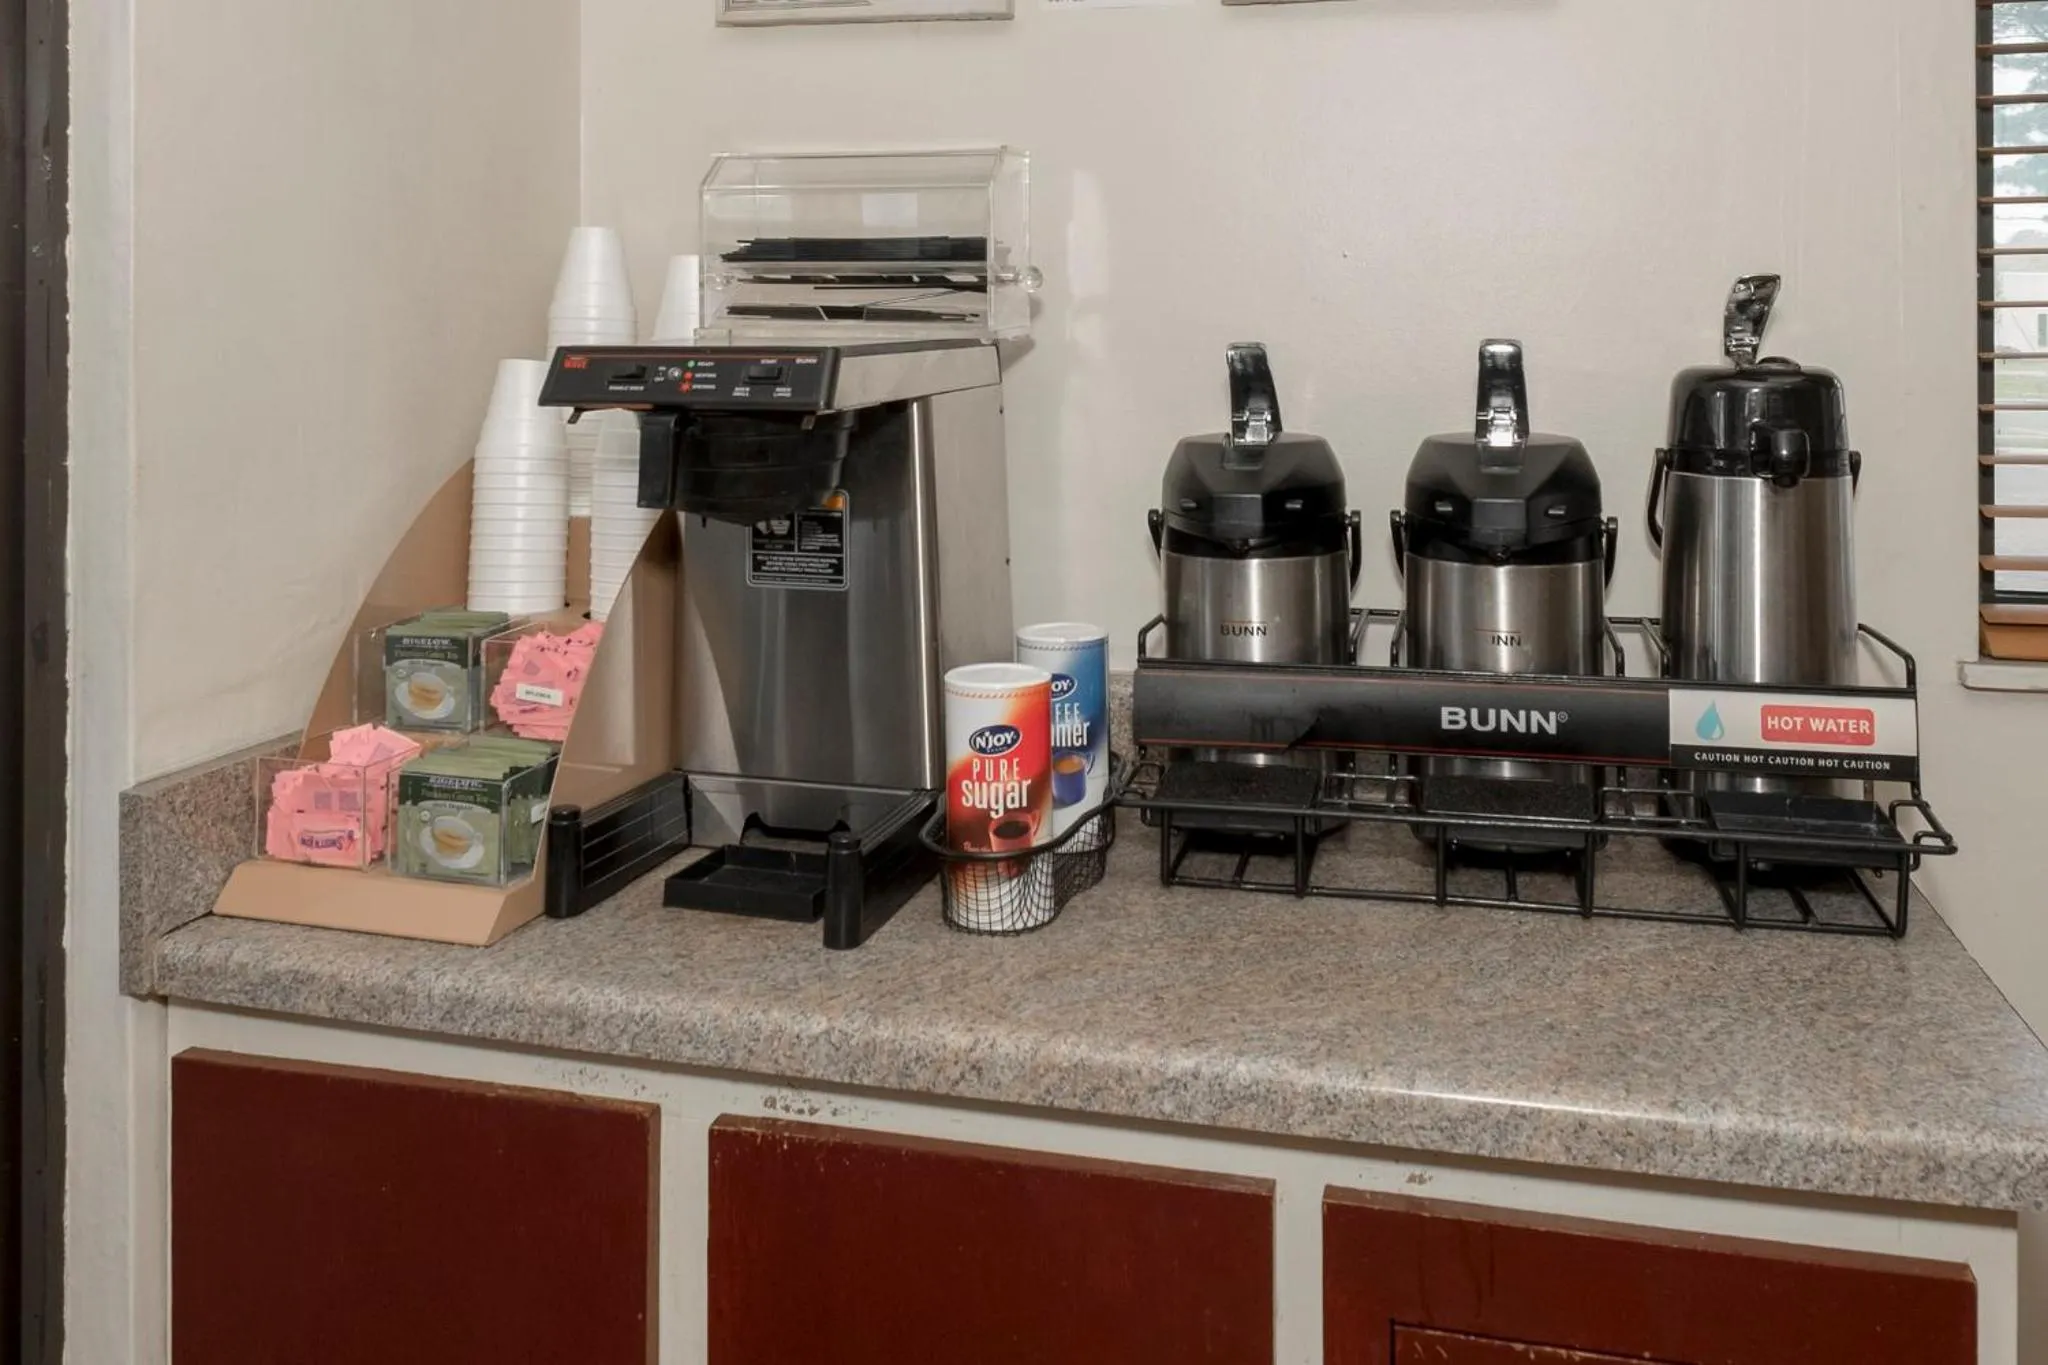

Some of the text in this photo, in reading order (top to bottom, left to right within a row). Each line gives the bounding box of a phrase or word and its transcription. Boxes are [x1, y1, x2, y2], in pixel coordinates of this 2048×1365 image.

[1220, 624, 1267, 637] BUNN
[1055, 702, 1080, 722] FEE
[1766, 716, 1871, 734] HOT WATER
[972, 758, 1021, 781] PURE
[1694, 752, 1891, 770] CAUTION HOT CAUTION HOT CAUTION
[961, 778, 1032, 819] sugar
